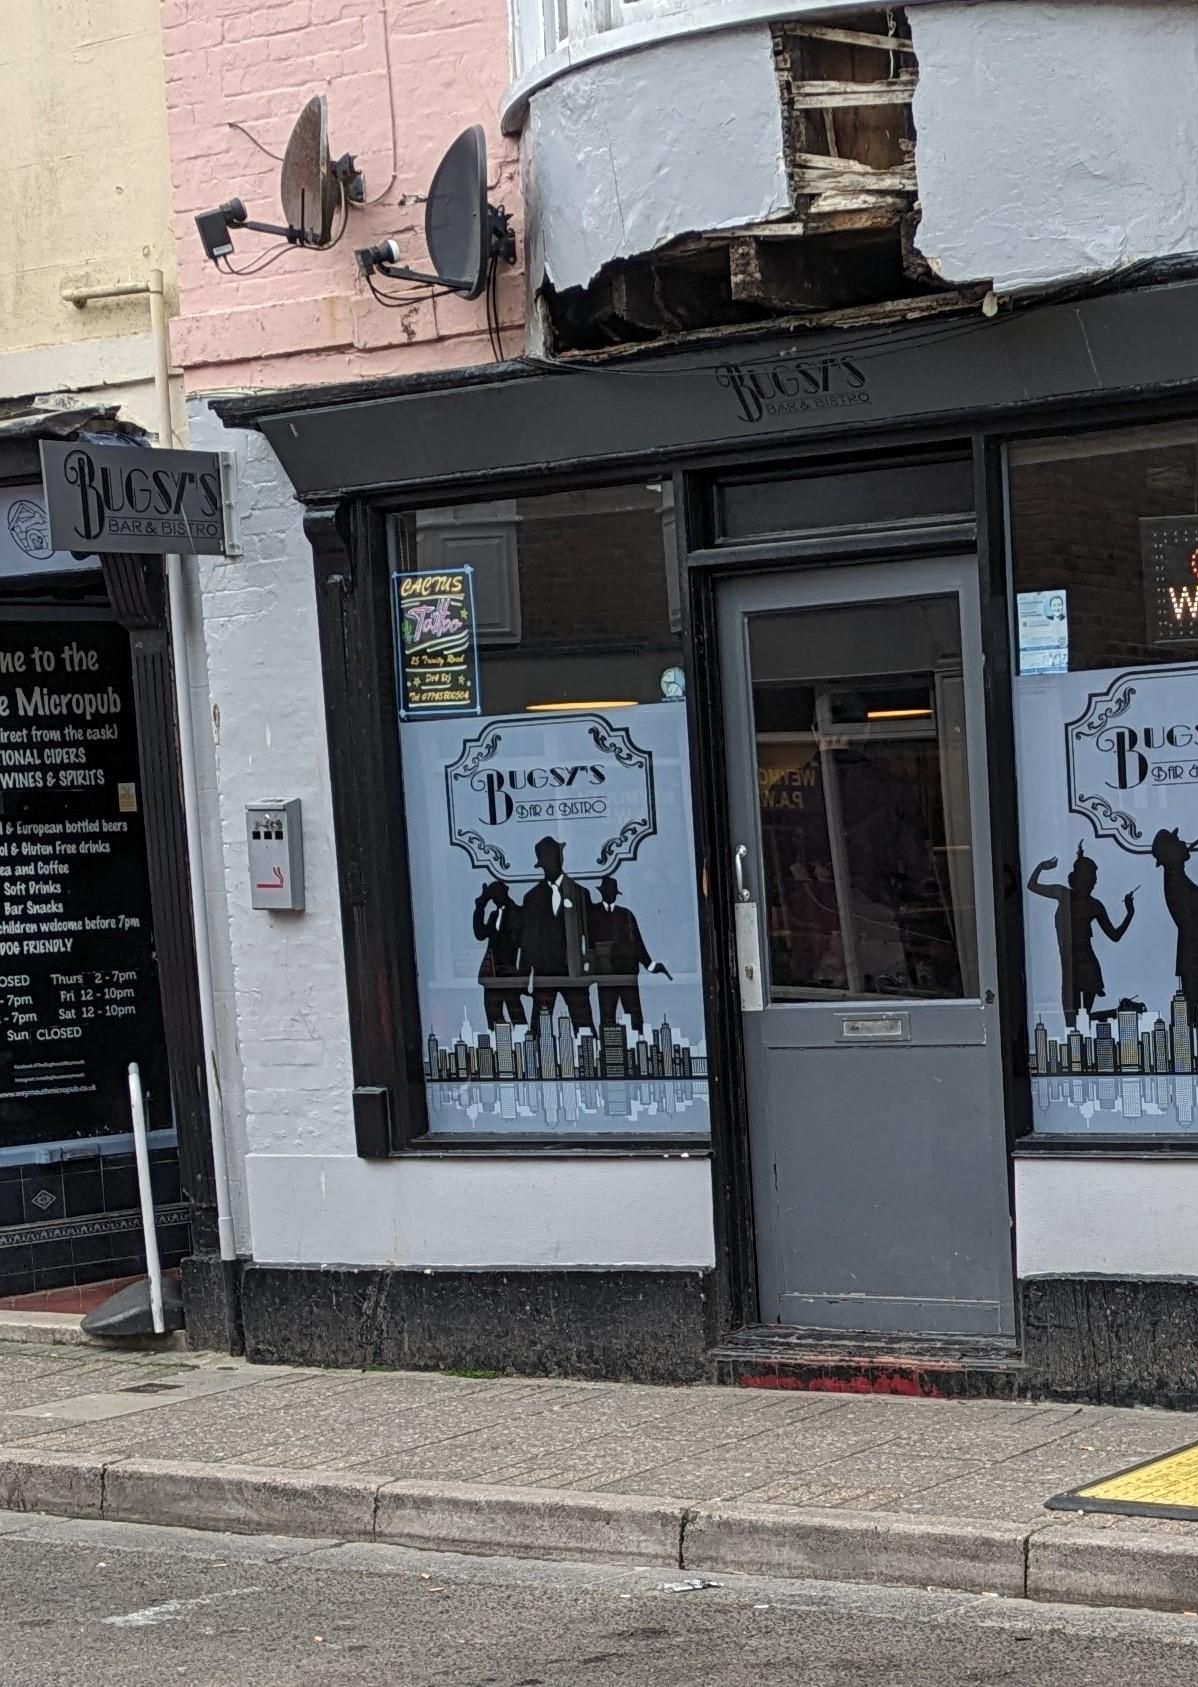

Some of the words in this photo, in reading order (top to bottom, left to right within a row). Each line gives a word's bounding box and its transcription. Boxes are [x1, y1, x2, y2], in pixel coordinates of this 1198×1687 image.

[816, 392, 870, 408] BISTRO
[64, 450, 219, 540] BUGSY'S
[108, 519, 142, 534] BAR
[146, 522, 157, 534] &
[162, 521, 218, 537] BISTRO
[401, 576, 463, 596] CACTUS
[405, 598, 463, 642] Tattoo
[30, 646, 55, 672] to
[60, 642, 99, 672] the
[15, 686, 121, 721] Micropub
[31, 725, 61, 742] from
[64, 724, 84, 740] the
[44, 747, 87, 765] CIDERS
[0, 771, 43, 790] WINES
[46, 771, 56, 787] &
[59, 769, 105, 787] SPIRITS
[470, 764, 606, 826] BUGSY'S
[6, 822, 14, 835] &
[16, 821, 63, 837] European
[65, 820, 100, 833] bottled
[102, 819, 128, 832] beers
[11, 843, 19, 856] &
[21, 842, 53, 855] Gluten
[55, 841, 77, 854] Free
[79, 840, 111, 854] drinks
[15, 862, 35, 876] and
[37, 860, 70, 875] Coffee
[4, 882, 26, 896] Soft
[28, 881, 62, 895] Drinks
[4, 902, 24, 916] Bar
[27, 900, 64, 914] Snacks
[40, 918, 83, 932] welcome
[85, 916, 117, 930] before
[118, 915, 140, 931] 7pm
[23, 938, 73, 955] FRIENDLY
[50, 974, 84, 985] Thurs
[95, 973, 103, 984] 2
[112, 971, 137, 984] 7pm
[7, 995, 34, 1008] 7pm
[60, 990, 76, 1002] Fri
[81, 989, 94, 1001] 12
[104, 987, 135, 1001] 10pm
[11, 1011, 38, 1026] 7pm
[59, 1008, 77, 1020] Sat
[82, 1006, 95, 1018] 12
[105, 1005, 137, 1018] 10pm
[7, 1030, 30, 1042] Sun
[36, 1026, 82, 1041] CLOSED
